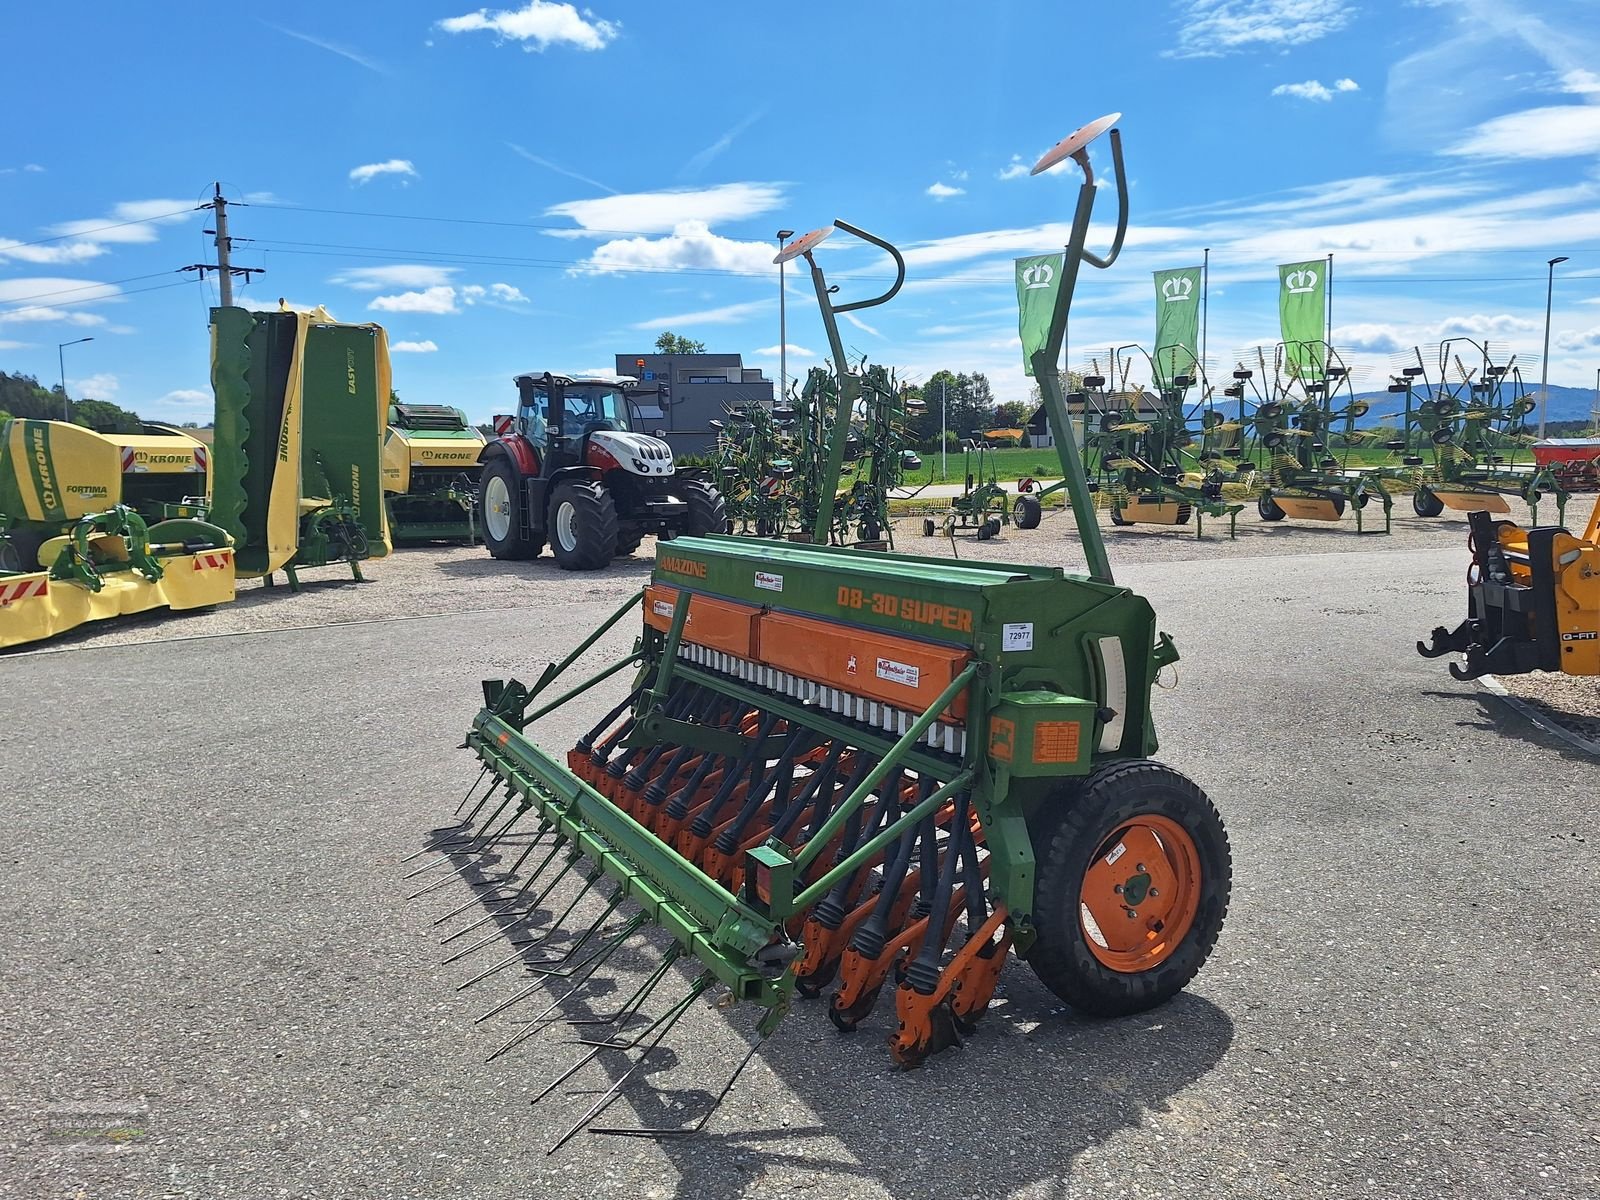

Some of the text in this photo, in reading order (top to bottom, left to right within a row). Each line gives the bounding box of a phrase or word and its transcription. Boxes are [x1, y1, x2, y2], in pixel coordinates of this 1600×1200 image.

[33, 427, 53, 490] KRONE
[149, 455, 192, 464] KRONE
[66, 485, 107, 494] FORTIMA
[351, 464, 360, 506] KRONE
[660, 555, 707, 578] AMAZONE
[900, 597, 973, 633] SUPER
[1009, 631, 1031, 640] 72977
